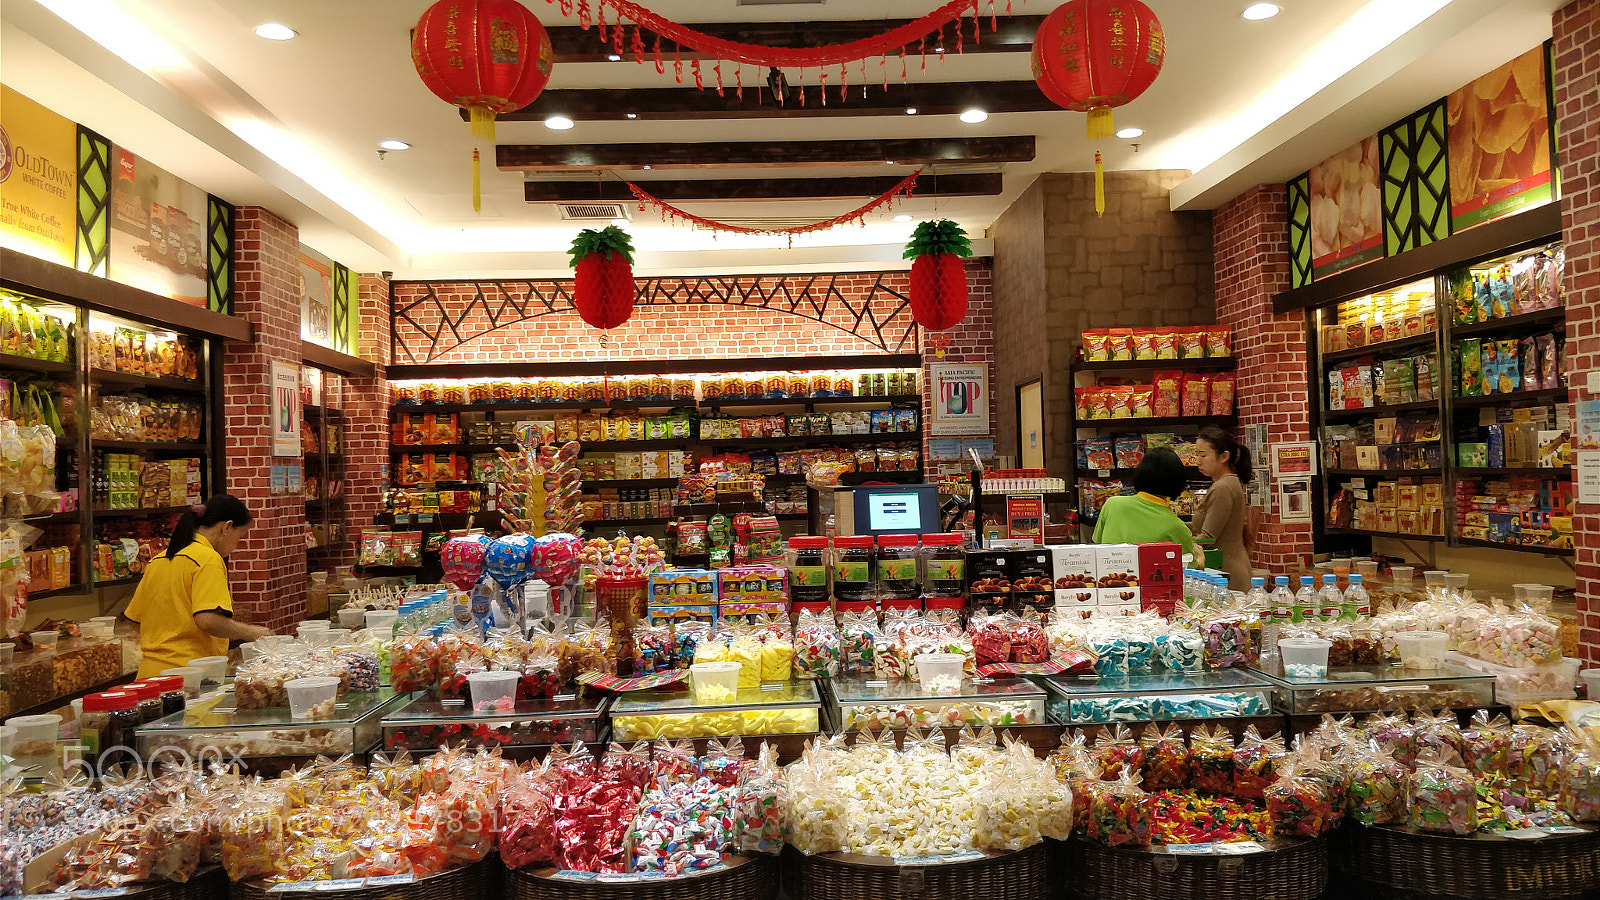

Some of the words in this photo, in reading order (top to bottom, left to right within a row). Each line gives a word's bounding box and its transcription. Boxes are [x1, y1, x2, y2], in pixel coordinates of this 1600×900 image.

[22, 172, 44, 190] WHITE
[44, 182, 67, 200] COFFEE
[2, 198, 18, 212] True
[20, 204, 39, 220] White
[41, 212, 62, 229] Coffee
[18, 219, 36, 233] from
[940, 381, 981, 415] TOP
